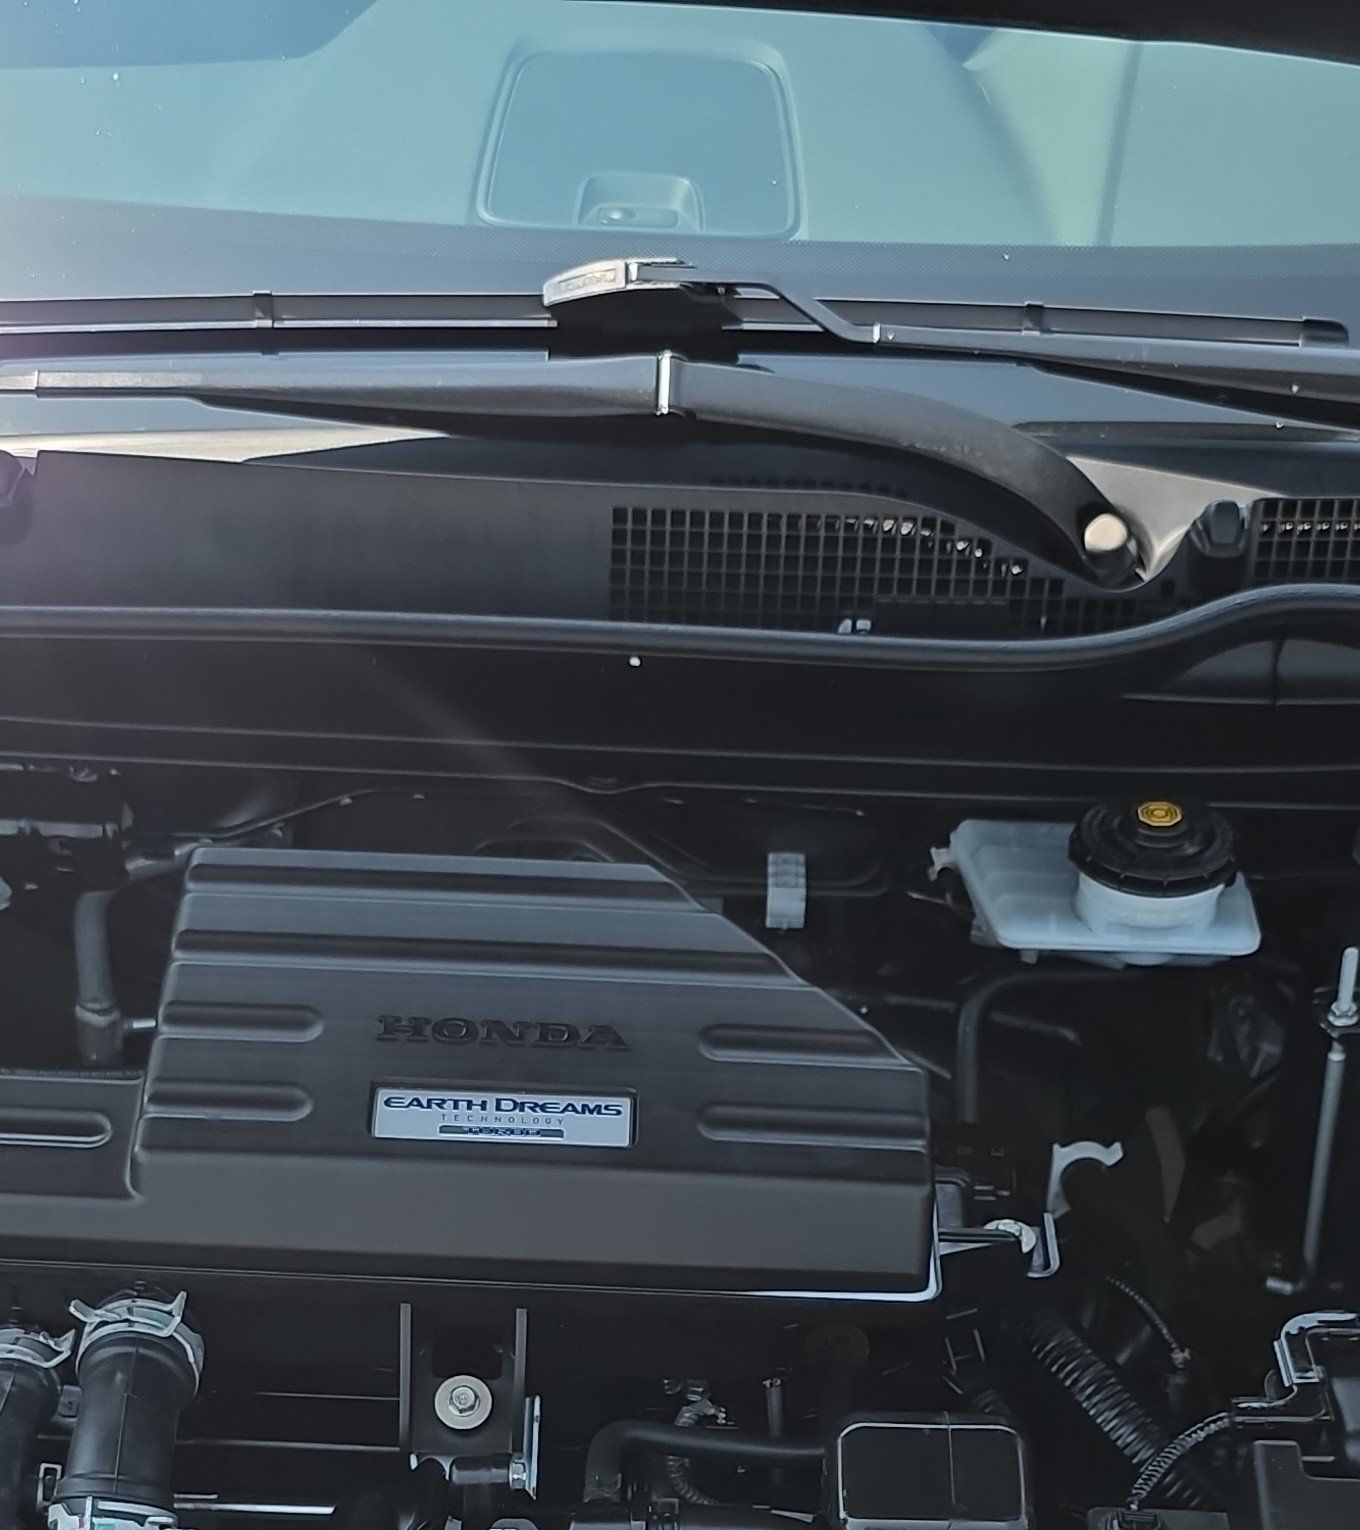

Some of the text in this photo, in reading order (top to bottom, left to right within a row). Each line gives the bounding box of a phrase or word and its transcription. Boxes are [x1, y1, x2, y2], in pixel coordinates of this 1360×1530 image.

[375, 1014, 632, 1050] HONDA
[383, 1096, 624, 1117] EARTH DREAMS
[440, 1113, 567, 1126] TECHNOLOGY
